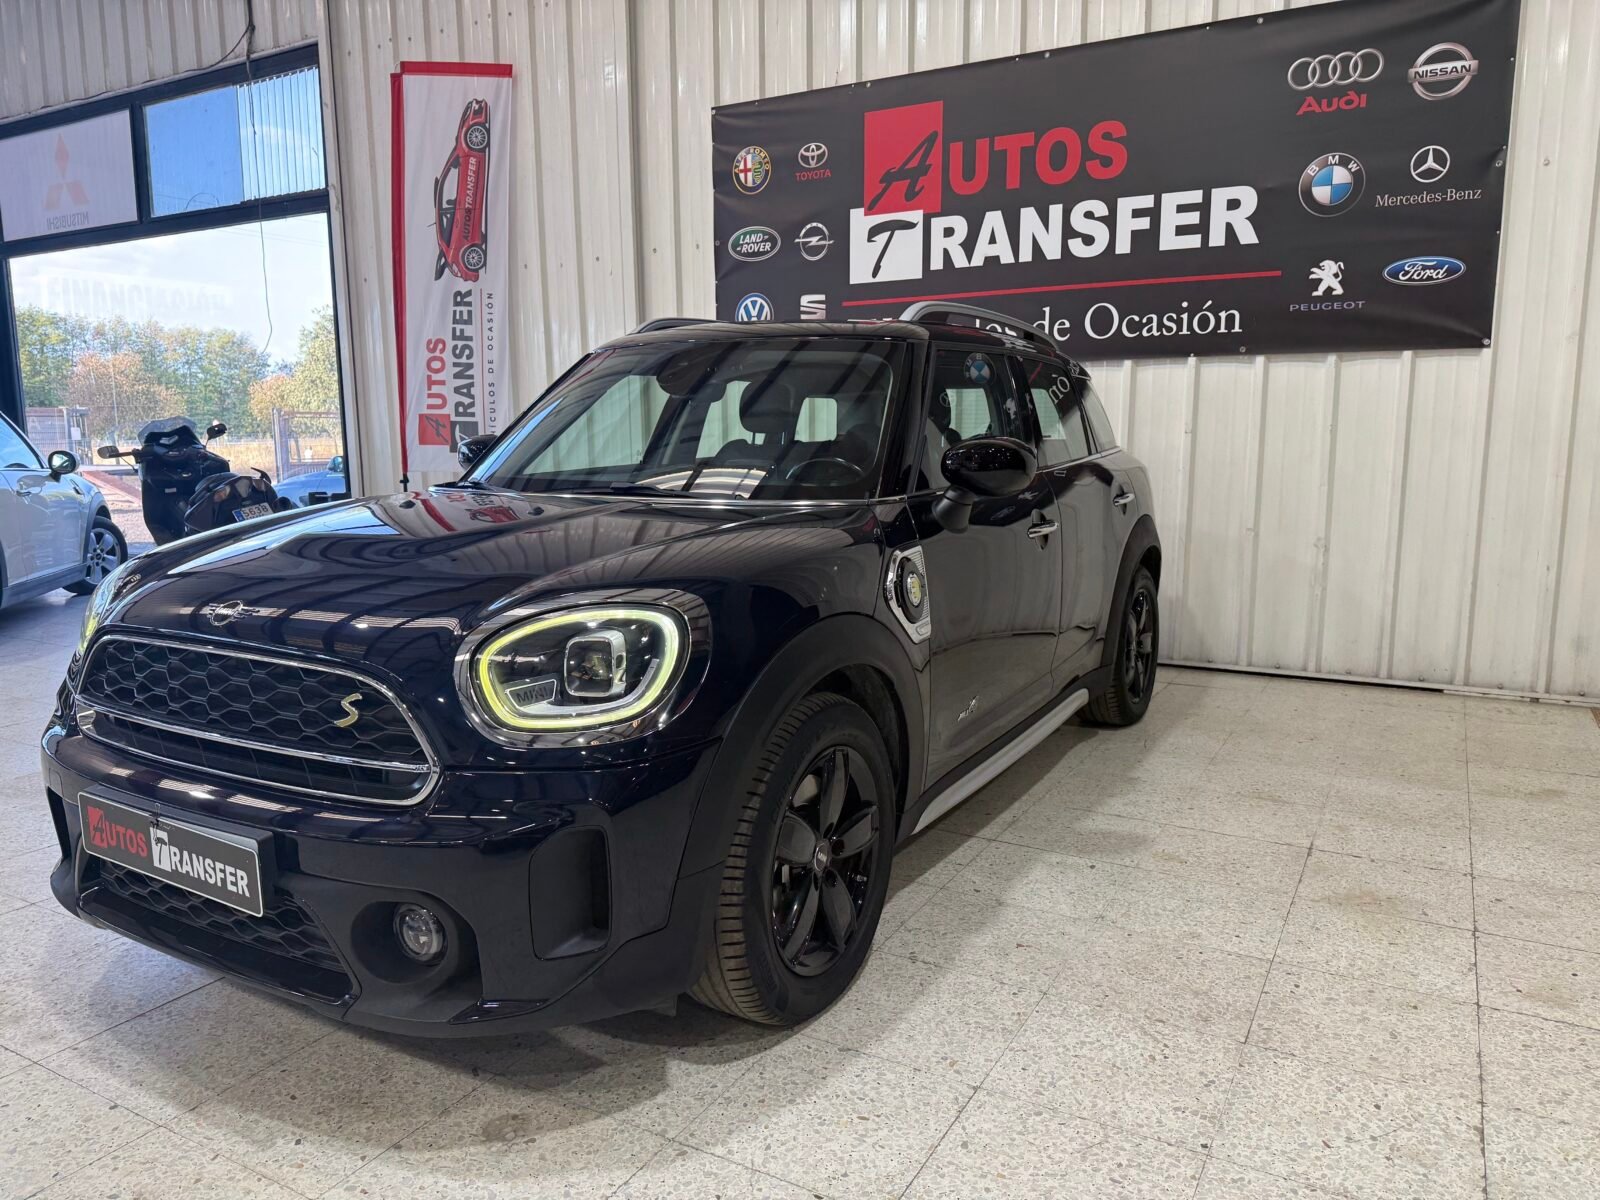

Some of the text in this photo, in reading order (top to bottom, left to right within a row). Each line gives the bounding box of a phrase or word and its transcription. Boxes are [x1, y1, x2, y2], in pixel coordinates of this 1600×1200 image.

[1413, 63, 1472, 79] NISSAN
[1296, 91, 1367, 115] Audi
[795, 168, 831, 182] TOYOTA
[867, 120, 1128, 211] AUTOS
[1307, 154, 1360, 177] BMW
[1375, 187, 1482, 208] Mercedes-Benz
[739, 233, 763, 245] LAND
[867, 185, 1260, 279] TRANSFER
[741, 242, 772, 253] ROVER
[1398, 265, 1448, 283] Ford
[1289, 300, 1367, 312] PEUGEOT
[486, 292, 495, 351] OCASIÓN
[1033, 306, 1071, 341] de
[1084, 301, 1243, 340] Ocasión
[488, 359, 495, 374] DE
[423, 337, 450, 444] AUTOS
[333, 692, 363, 728] S
[90, 808, 251, 898] AUTOS TRANSFER
